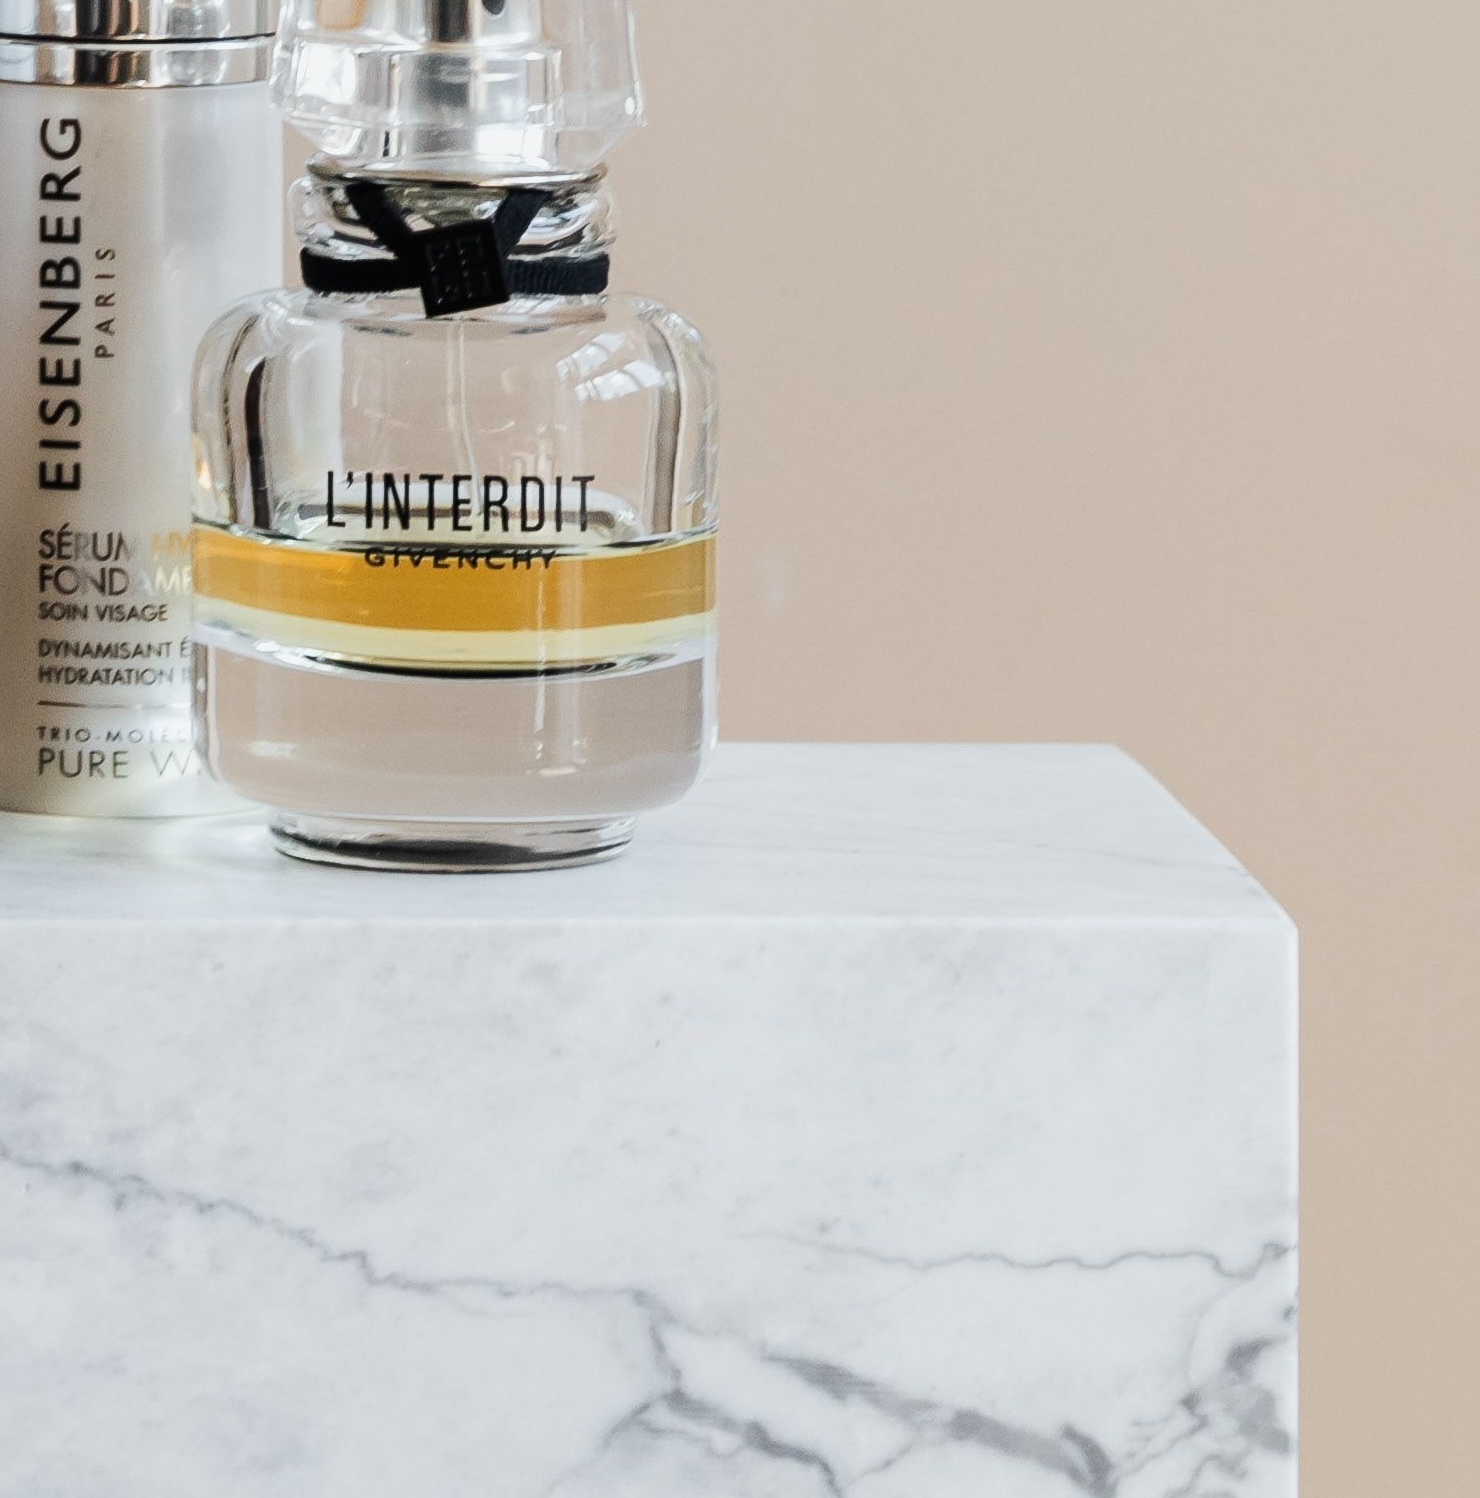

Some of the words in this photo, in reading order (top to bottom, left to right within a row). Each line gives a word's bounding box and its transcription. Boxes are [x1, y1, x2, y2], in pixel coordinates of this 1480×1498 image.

[39, 117, 82, 491] EISENBERG
[95, 248, 116, 359] PARIS
[326, 470, 596, 533] L'INTERDIT
[364, 547, 557, 570] GIVENCHY
[38, 602, 89, 622] SOIN
[95, 603, 168, 622] VISAGE
[39, 638, 173, 660] DYNAMISANT
[39, 666, 174, 686] HYDRATATION
[38, 747, 130, 779] PURE
